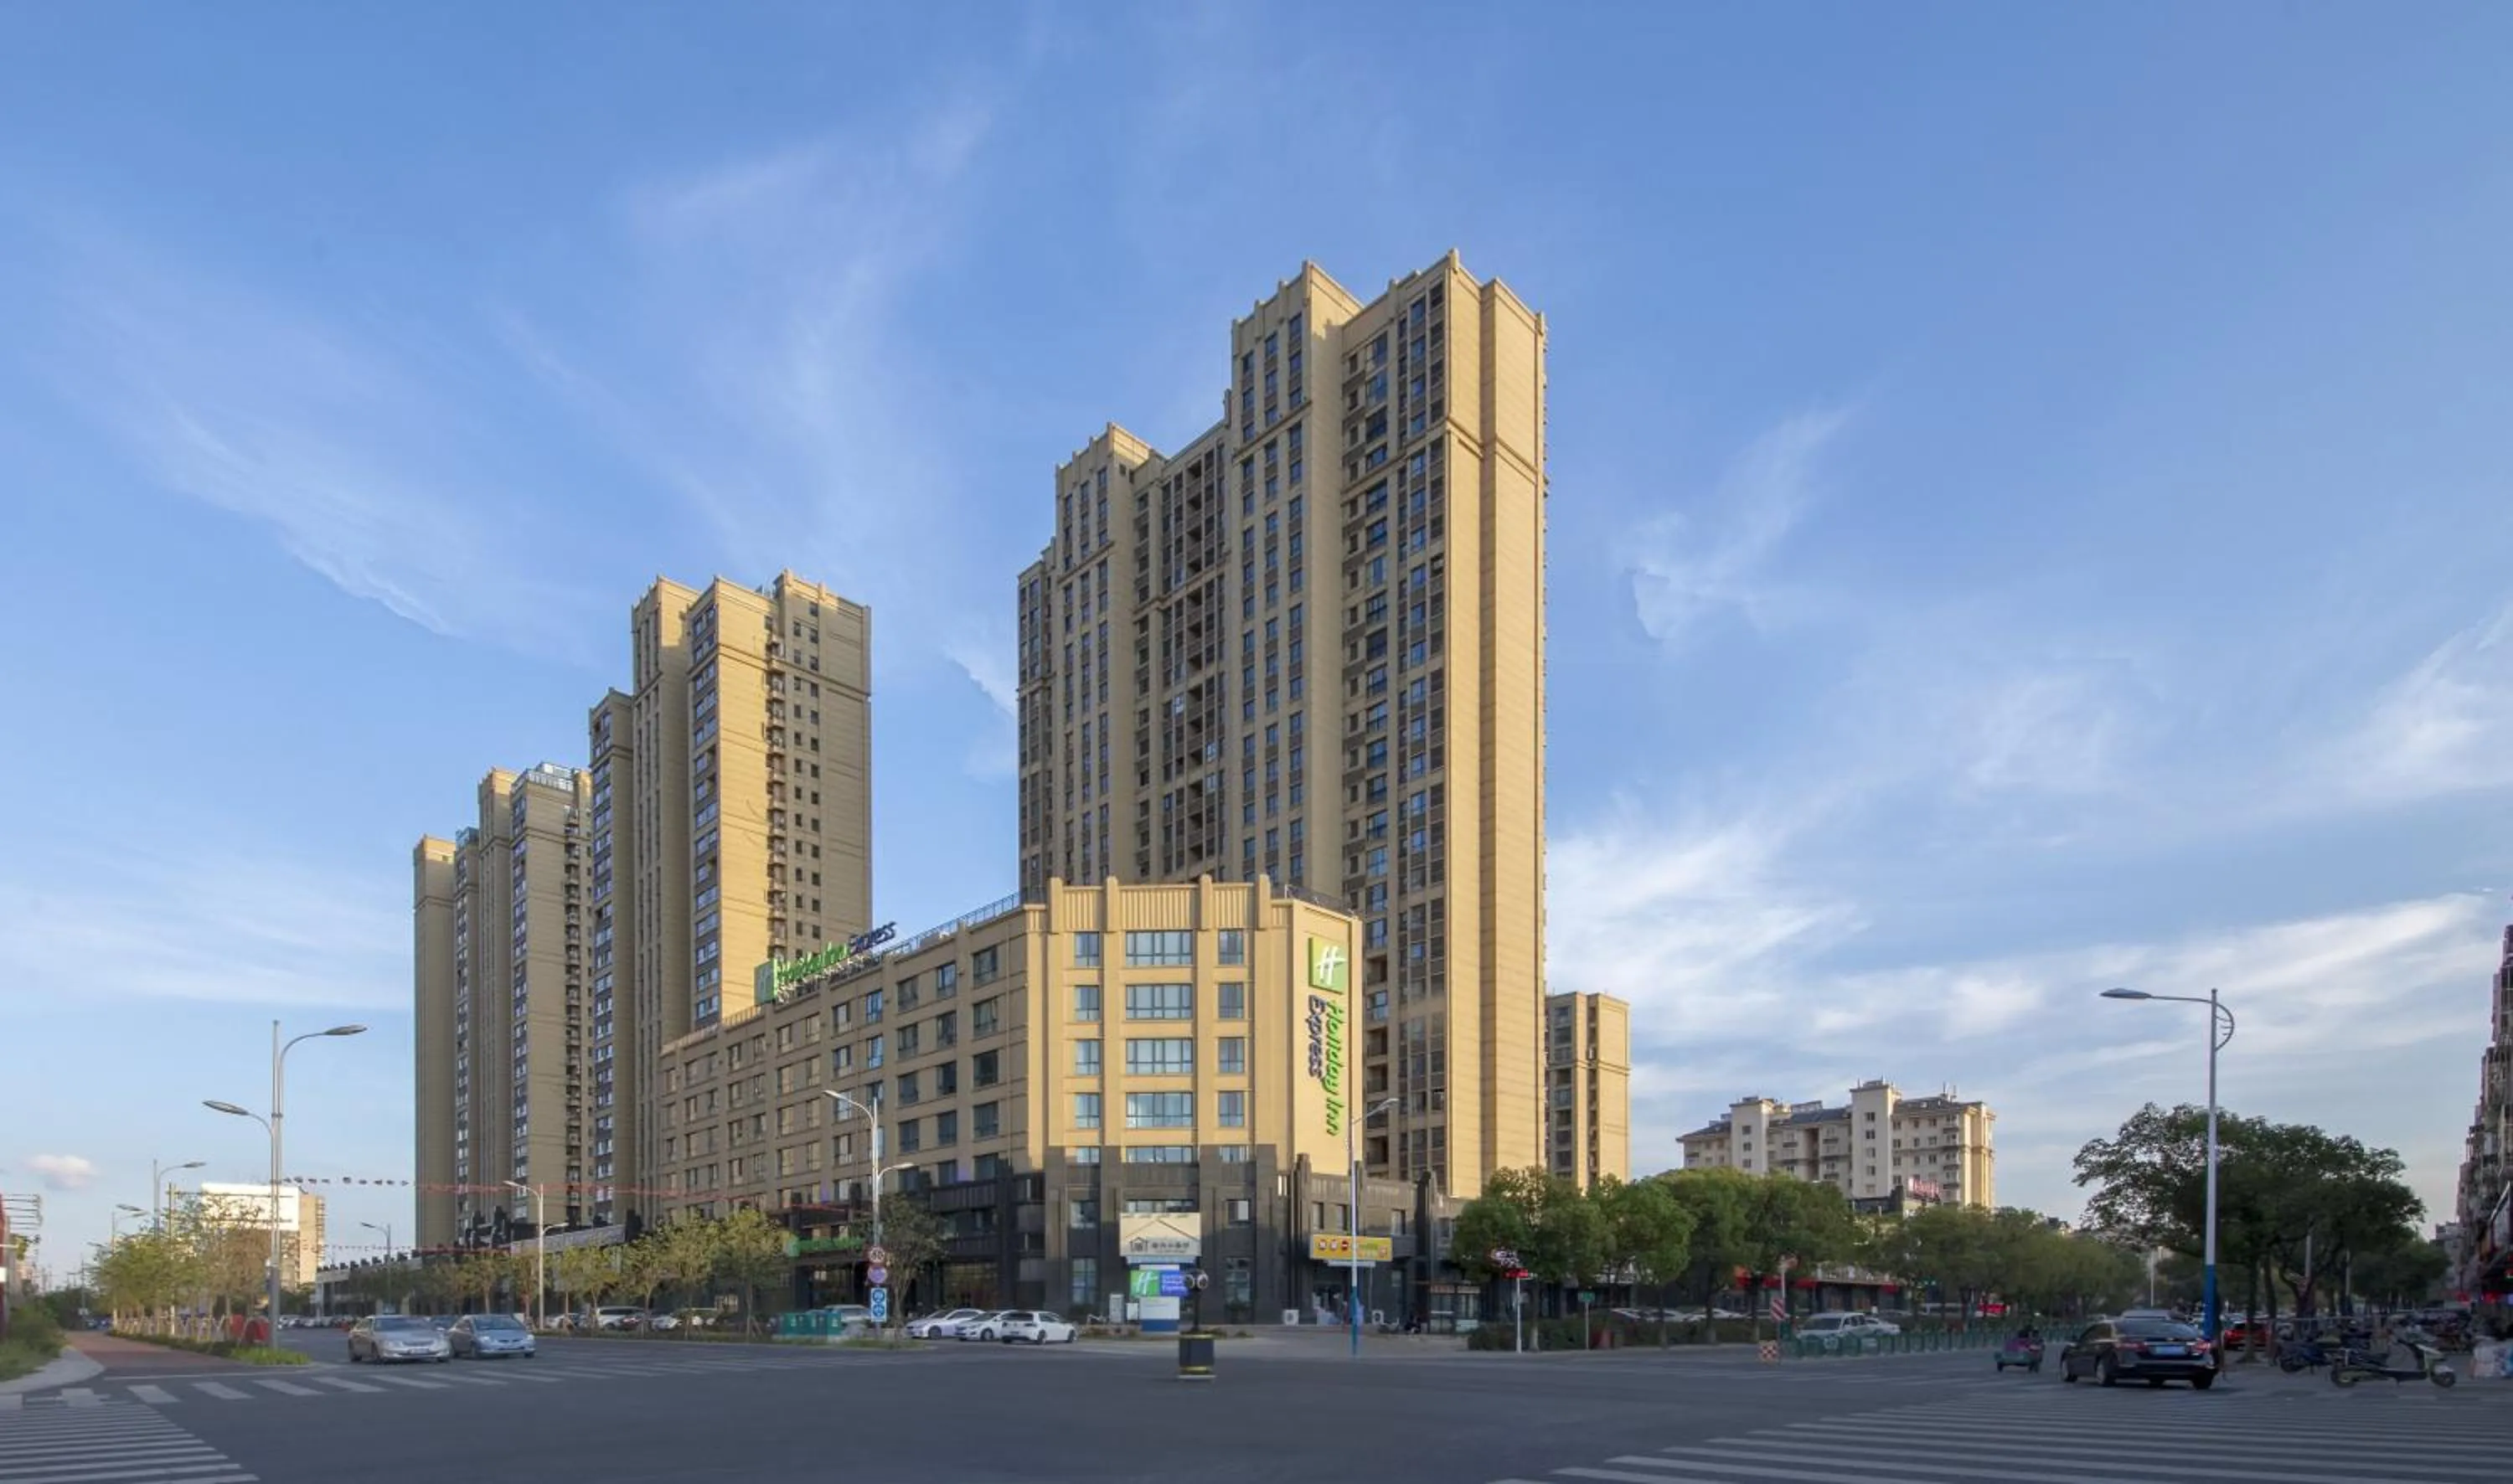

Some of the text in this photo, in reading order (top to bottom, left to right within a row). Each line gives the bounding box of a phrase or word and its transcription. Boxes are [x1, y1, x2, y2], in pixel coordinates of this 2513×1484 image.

[1305, 994, 1326, 1079] Express
[1321, 1000, 1345, 1136] Holiday Inn
